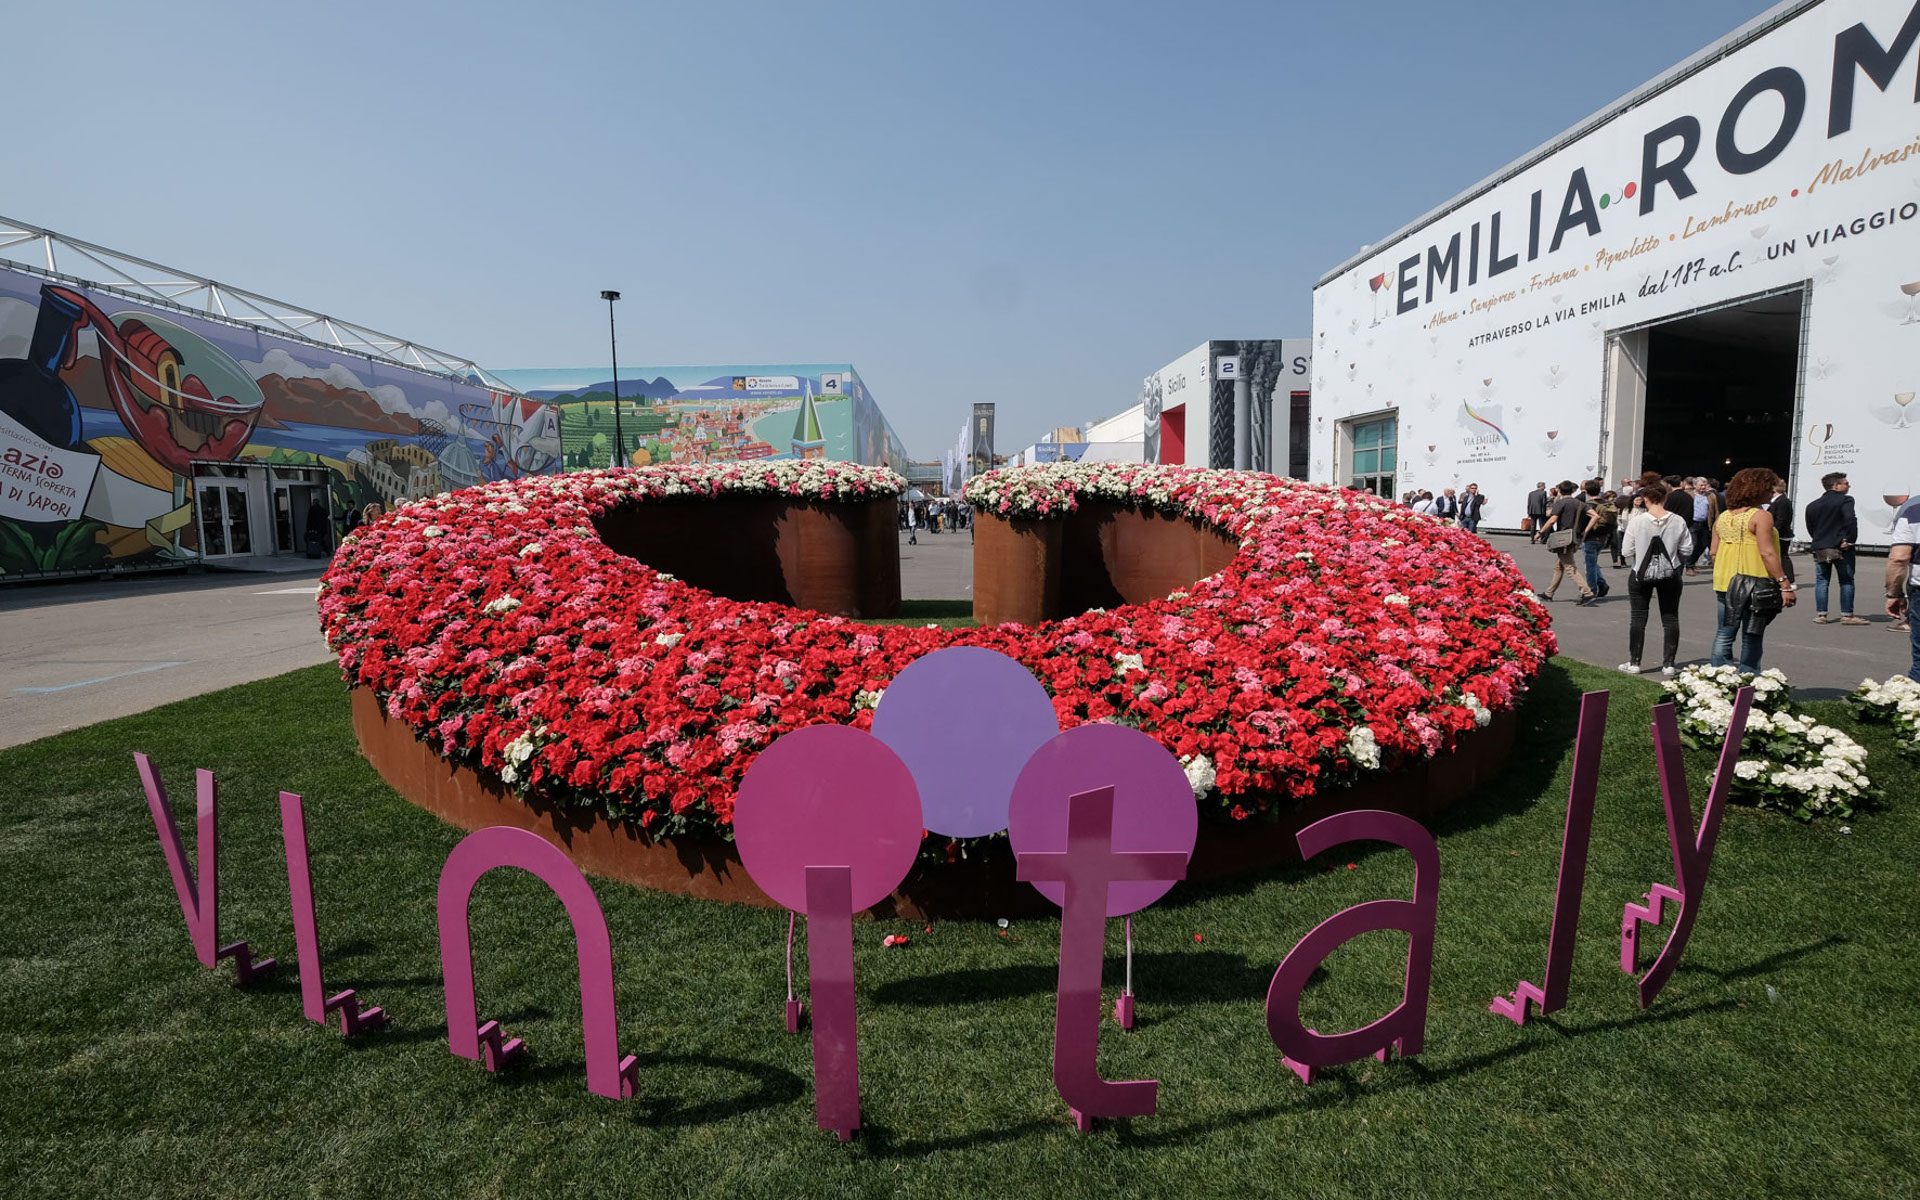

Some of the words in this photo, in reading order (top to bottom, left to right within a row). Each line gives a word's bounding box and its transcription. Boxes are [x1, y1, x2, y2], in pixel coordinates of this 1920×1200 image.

[1397, 166, 1602, 316] EMILIA
[1639, 0, 1920, 217] ROM
[1428, 310, 1460, 329] Albana
[1528, 267, 1579, 292] Fortana
[1596, 235, 1660, 271] Pignoletto
[1682, 195, 1778, 239] Lambrusco
[1807, 136, 1920, 193] Malvasi
[1468, 319, 1532, 348] ATTRAVERSO
[1536, 316, 1550, 329] LA
[1555, 306, 1577, 322] VIA
[1580, 292, 1626, 315] EMILIA
[1638, 269, 1669, 298] dal
[1672, 257, 1706, 287] 187
[1767, 239, 1796, 260] UN
[1806, 202, 1919, 248] VIAGGIO
[1222, 362, 1234, 373] 2
[1292, 356, 1311, 376] S
[825, 379, 838, 390] 4
[1168, 373, 1186, 395] Sicilia
[547, 417, 556, 432] A
[1463, 438, 1475, 446] VIA
[0, 447, 64, 479] azio
[0, 462, 32, 483] TERNA
[36, 475, 76, 498] SCOPERTA
[8, 486, 23, 501] DI
[27, 491, 71, 518] SAPORI
